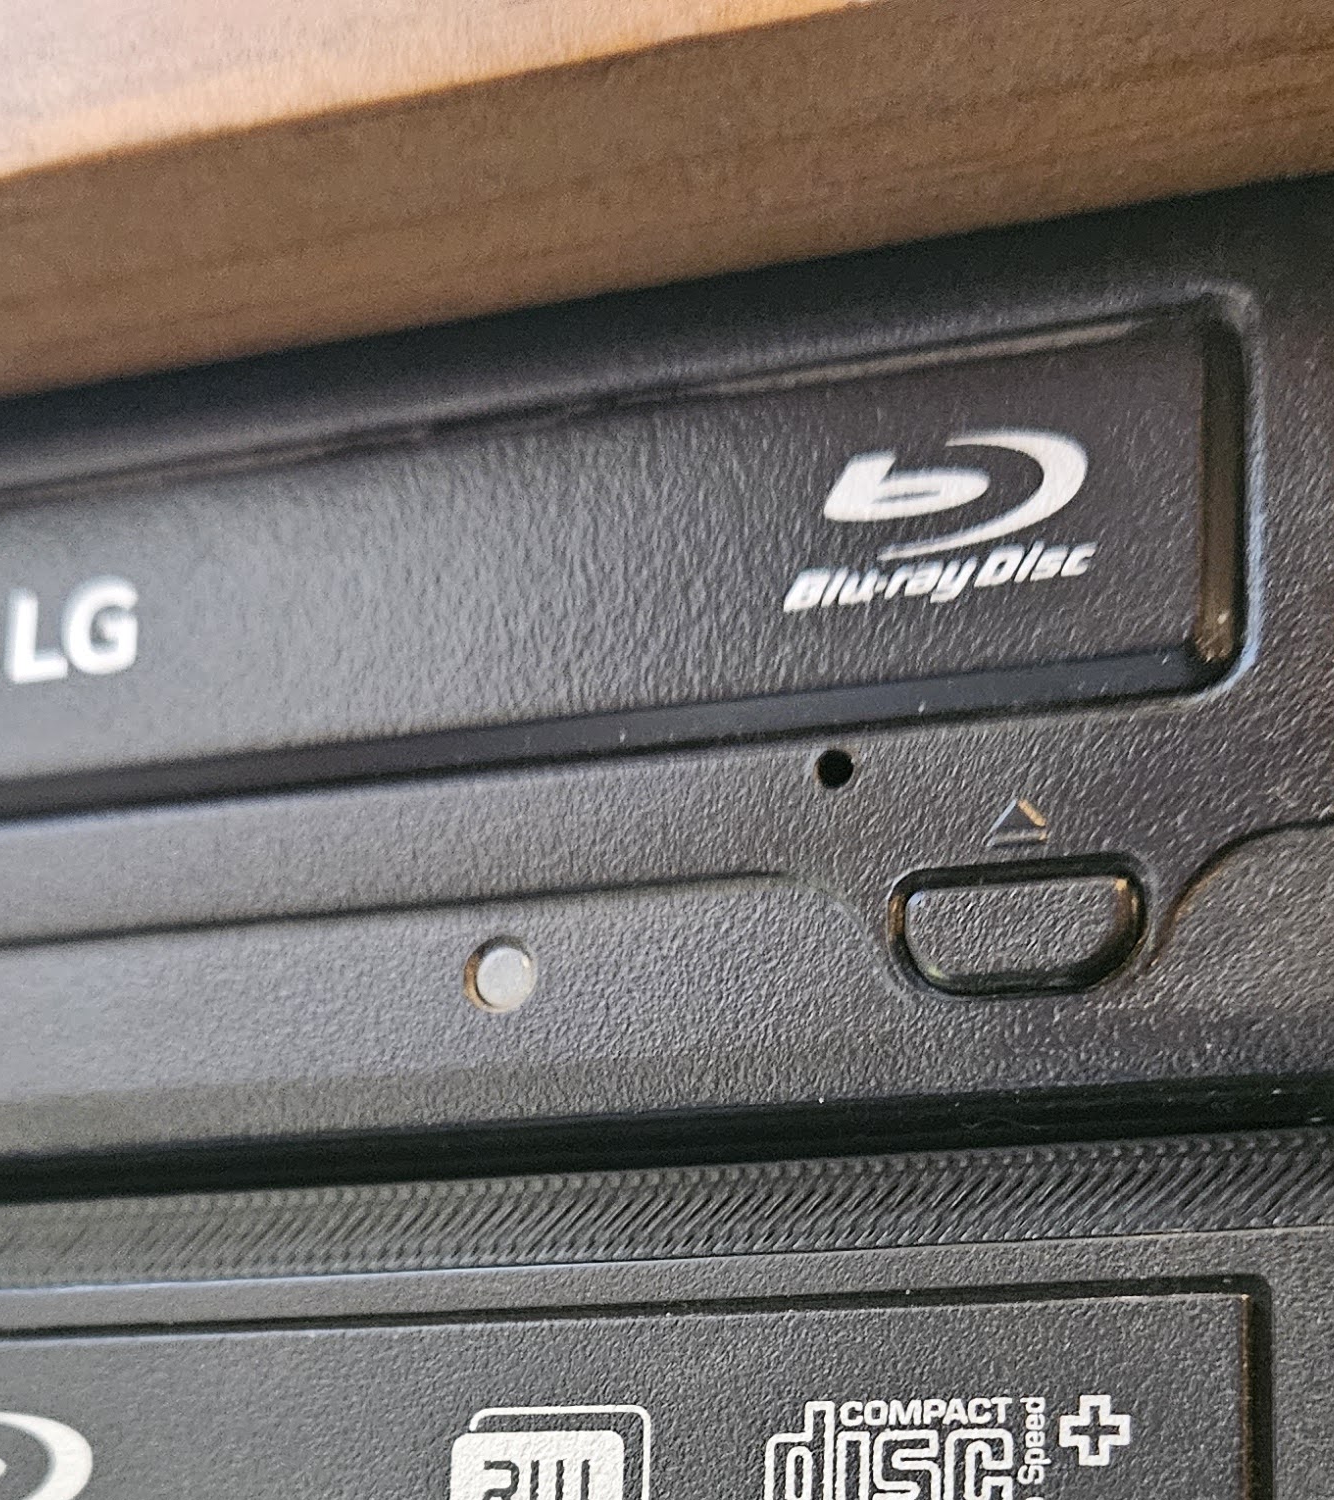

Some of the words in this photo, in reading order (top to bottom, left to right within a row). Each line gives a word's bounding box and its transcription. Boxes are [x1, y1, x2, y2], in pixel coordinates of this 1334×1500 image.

[974, 541, 1099, 588] Disc
[4, 575, 139, 684] LG
[839, 1397, 1013, 1426] COMPACT
[1016, 1396, 1051, 1486] Speed
